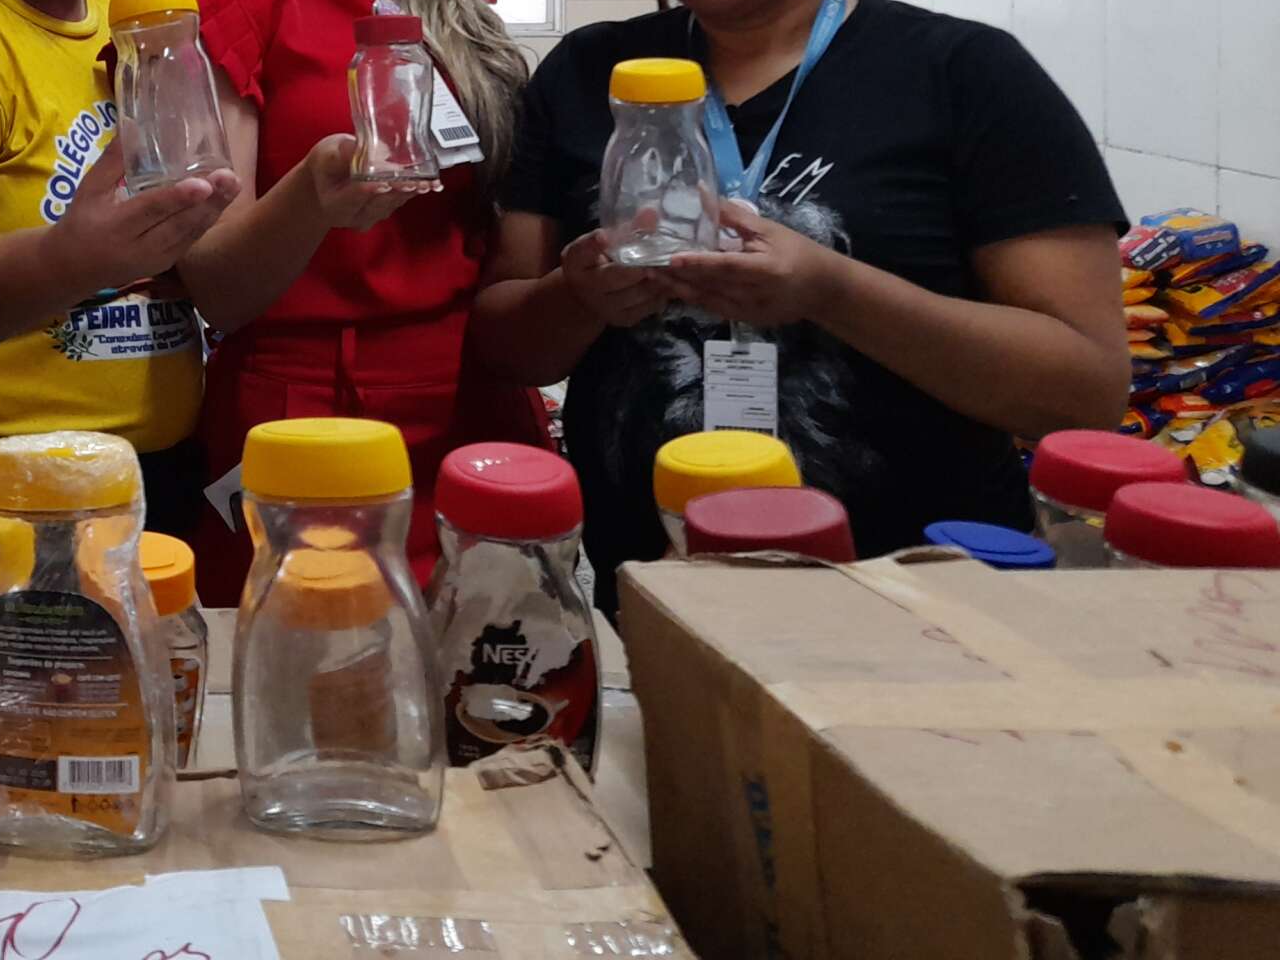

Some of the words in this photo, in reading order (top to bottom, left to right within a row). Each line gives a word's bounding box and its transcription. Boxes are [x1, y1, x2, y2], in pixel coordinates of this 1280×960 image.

[43, 112, 101, 222] COLÉGIO
[96, 101, 118, 129] JO
[70, 303, 142, 332] FEIRA
